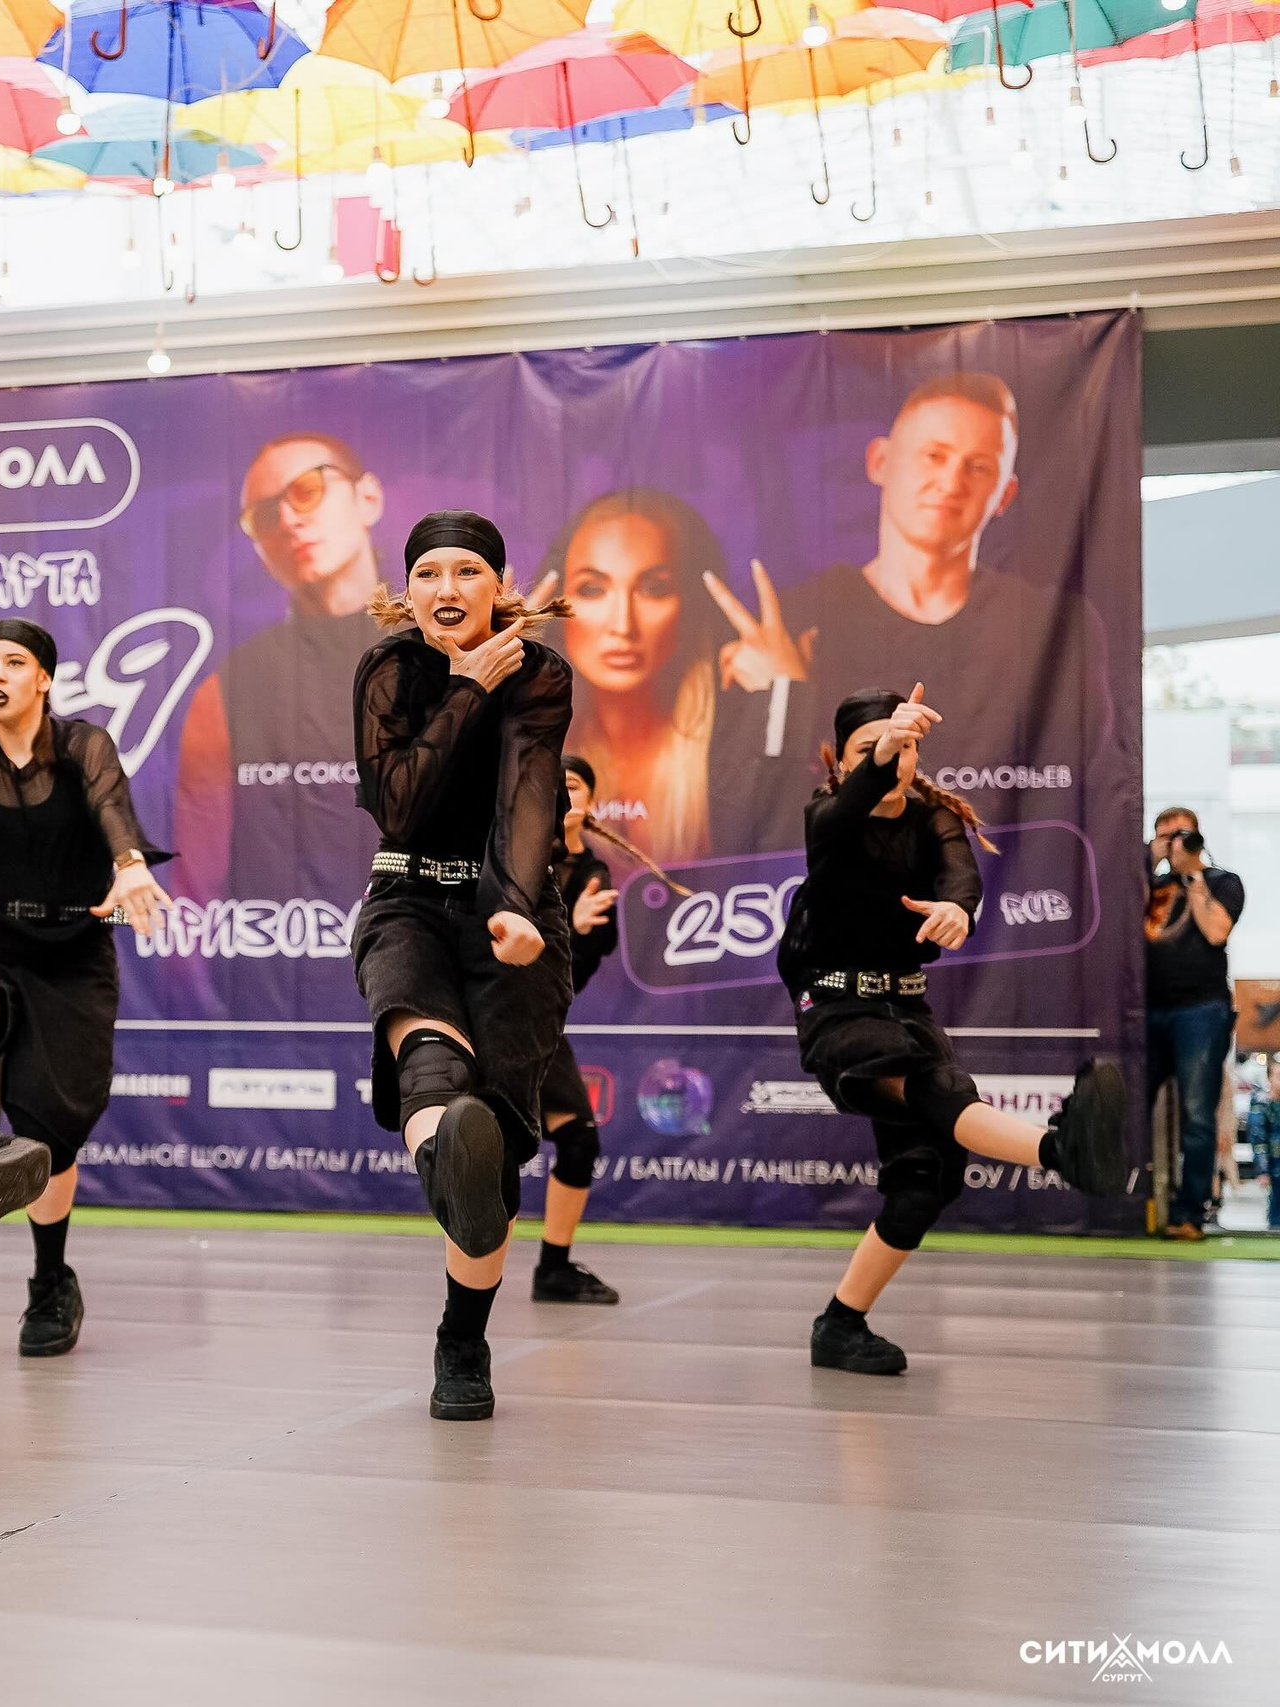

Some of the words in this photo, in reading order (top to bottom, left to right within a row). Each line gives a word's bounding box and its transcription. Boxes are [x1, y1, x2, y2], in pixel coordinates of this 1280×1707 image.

[238, 762, 293, 785] ЕГОР
[294, 761, 360, 785] СОКО
[936, 764, 1072, 791] СОЛОВЬЕВ
[1000, 888, 1072, 926] RUB
[135, 896, 362, 959] ПРИЗОВ
[76, 1141, 190, 1169] ЕВАЛЬНОЕ
[191, 1144, 249, 1170] ШОУ
[266, 1146, 349, 1172] БАТТЛЫ
[629, 1156, 719, 1182] БАТТЛЫ
[739, 1157, 878, 1186] ТАНЦЕВАЛЬ
[963, 1164, 1004, 1190] ОУ
